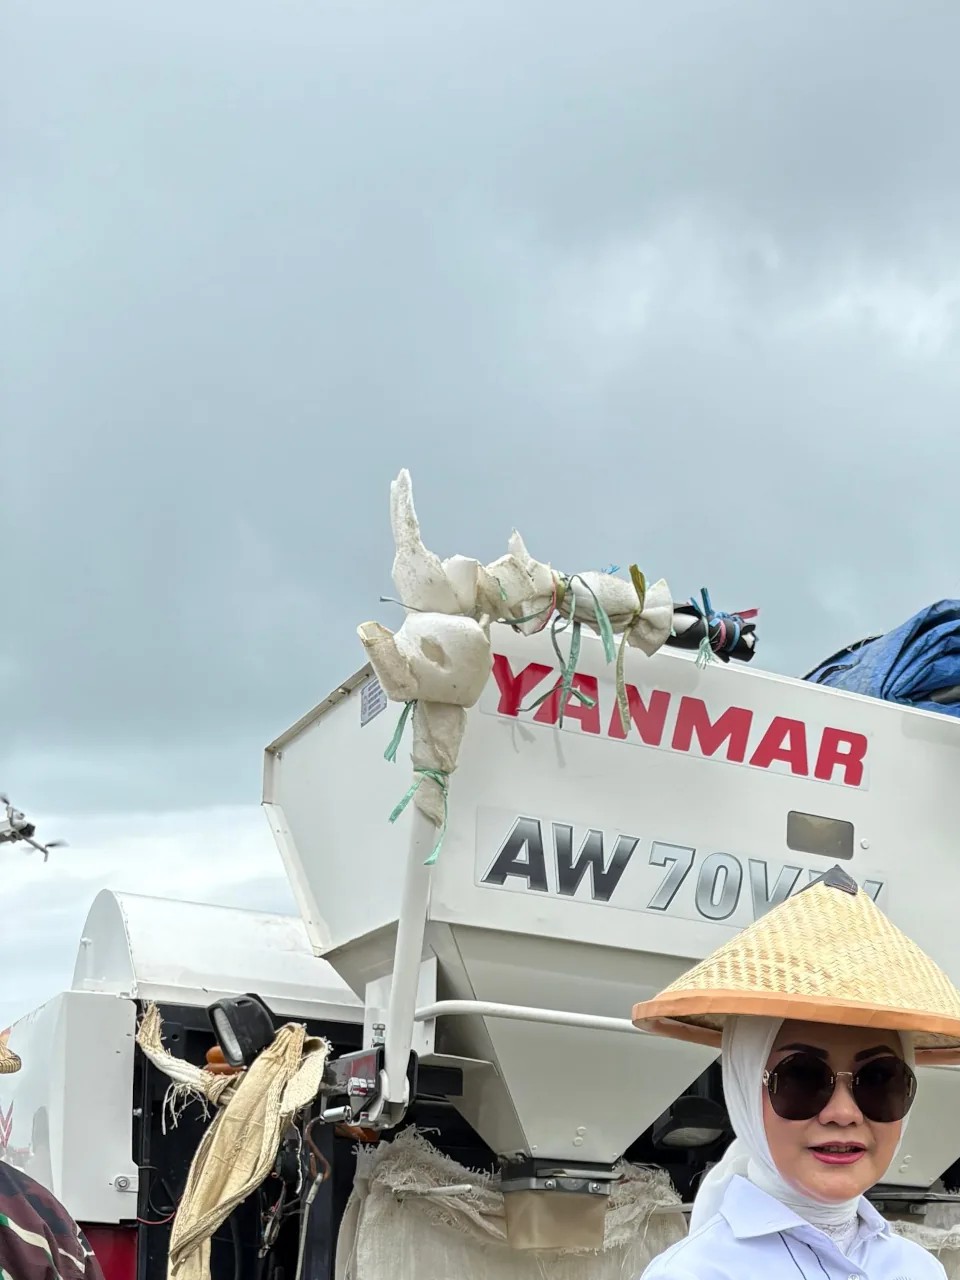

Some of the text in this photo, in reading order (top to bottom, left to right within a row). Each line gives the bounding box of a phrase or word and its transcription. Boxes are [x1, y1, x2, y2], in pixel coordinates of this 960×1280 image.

[492, 653, 869, 787] YANMAR
[479, 816, 884, 921] AW 70V
